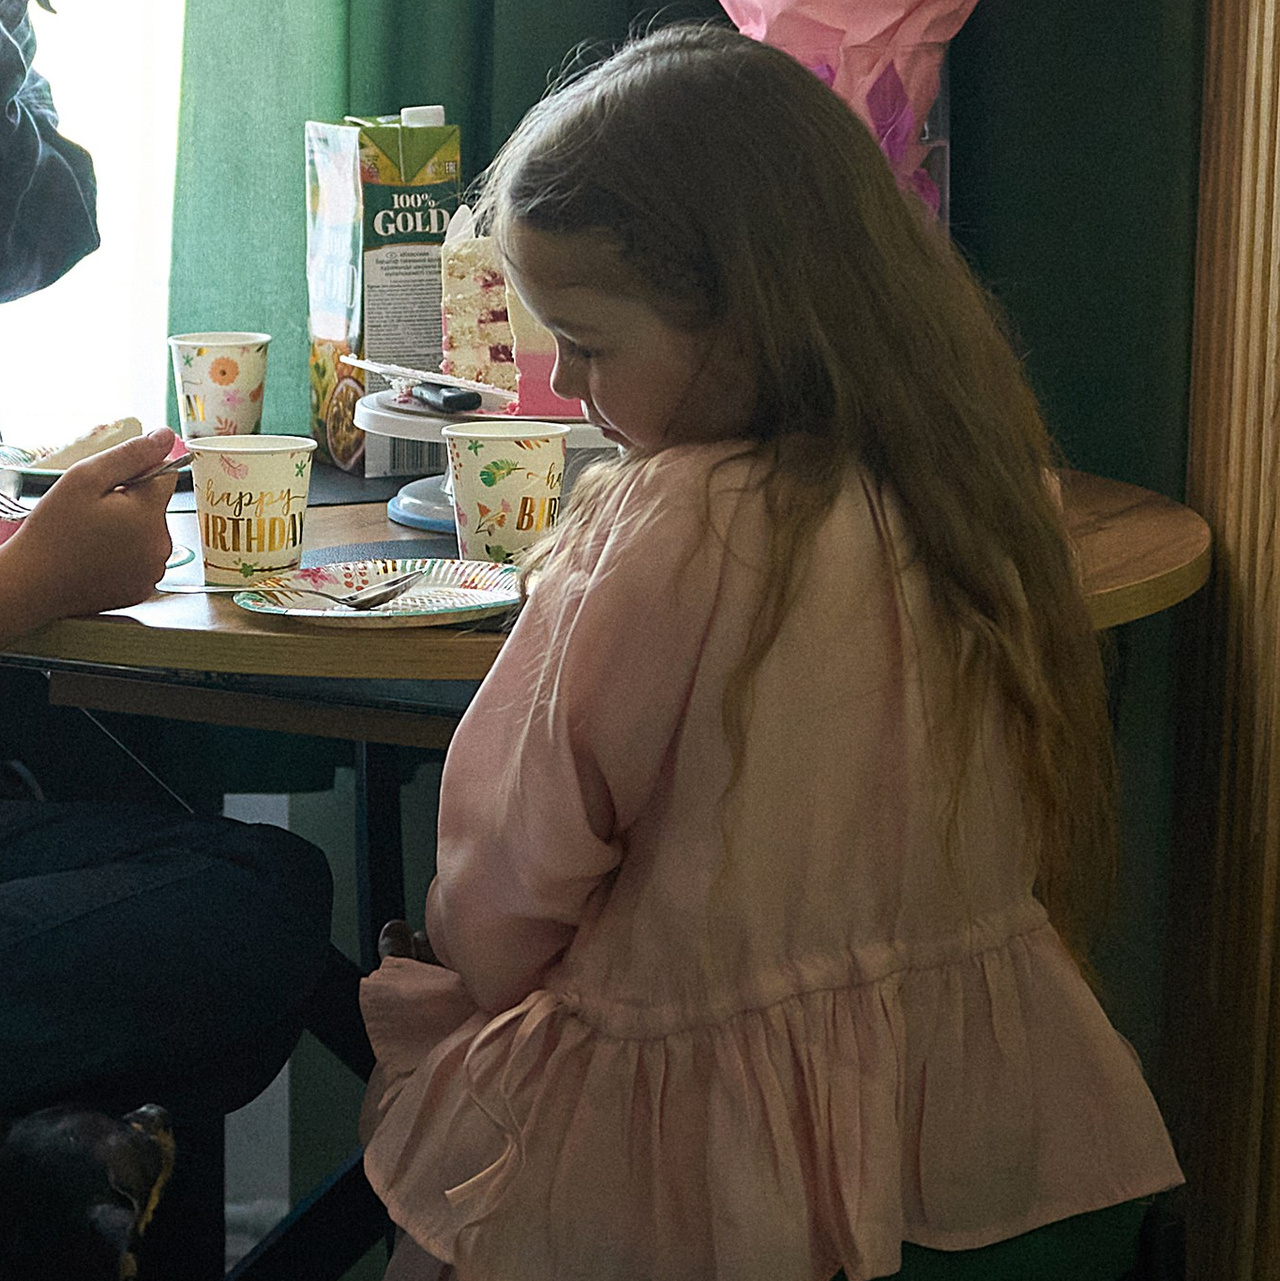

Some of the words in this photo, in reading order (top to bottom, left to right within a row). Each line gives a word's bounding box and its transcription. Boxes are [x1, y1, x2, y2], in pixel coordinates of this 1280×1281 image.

[392, 193, 435, 209] 100%
[373, 208, 451, 236] GOLD
[205, 478, 306, 518] happy
